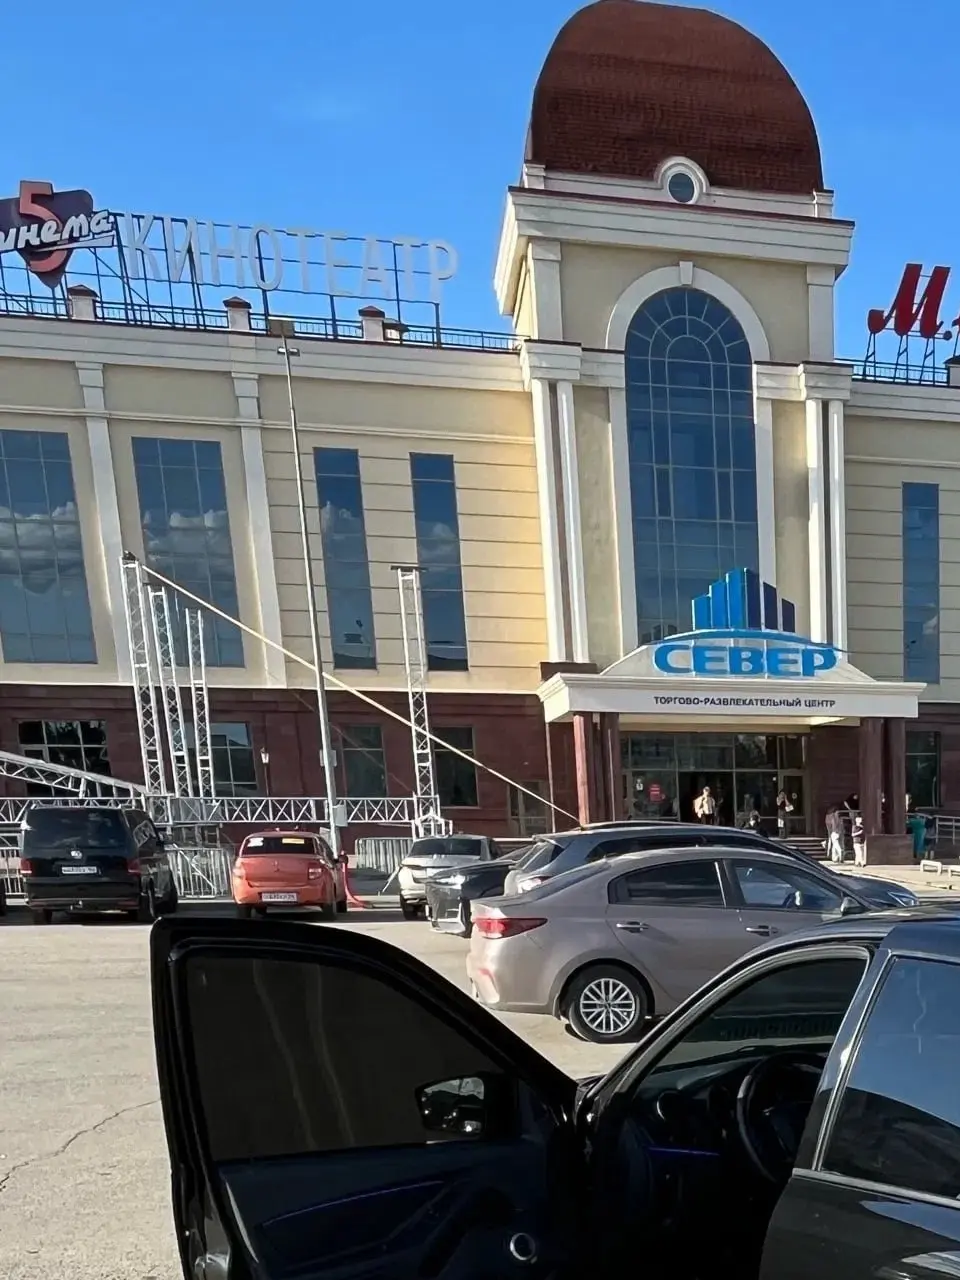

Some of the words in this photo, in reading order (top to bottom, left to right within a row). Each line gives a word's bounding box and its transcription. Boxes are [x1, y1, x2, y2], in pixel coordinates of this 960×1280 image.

[124, 212, 459, 303] КИНОТЕАТР
[653, 643, 838, 678] СЕВЕР
[653, 696, 802, 708] ТОРГОВО-РАЗВЛЕКАТЕЛЬНЫЙ
[804, 699, 836, 708] ЦЕНТР
